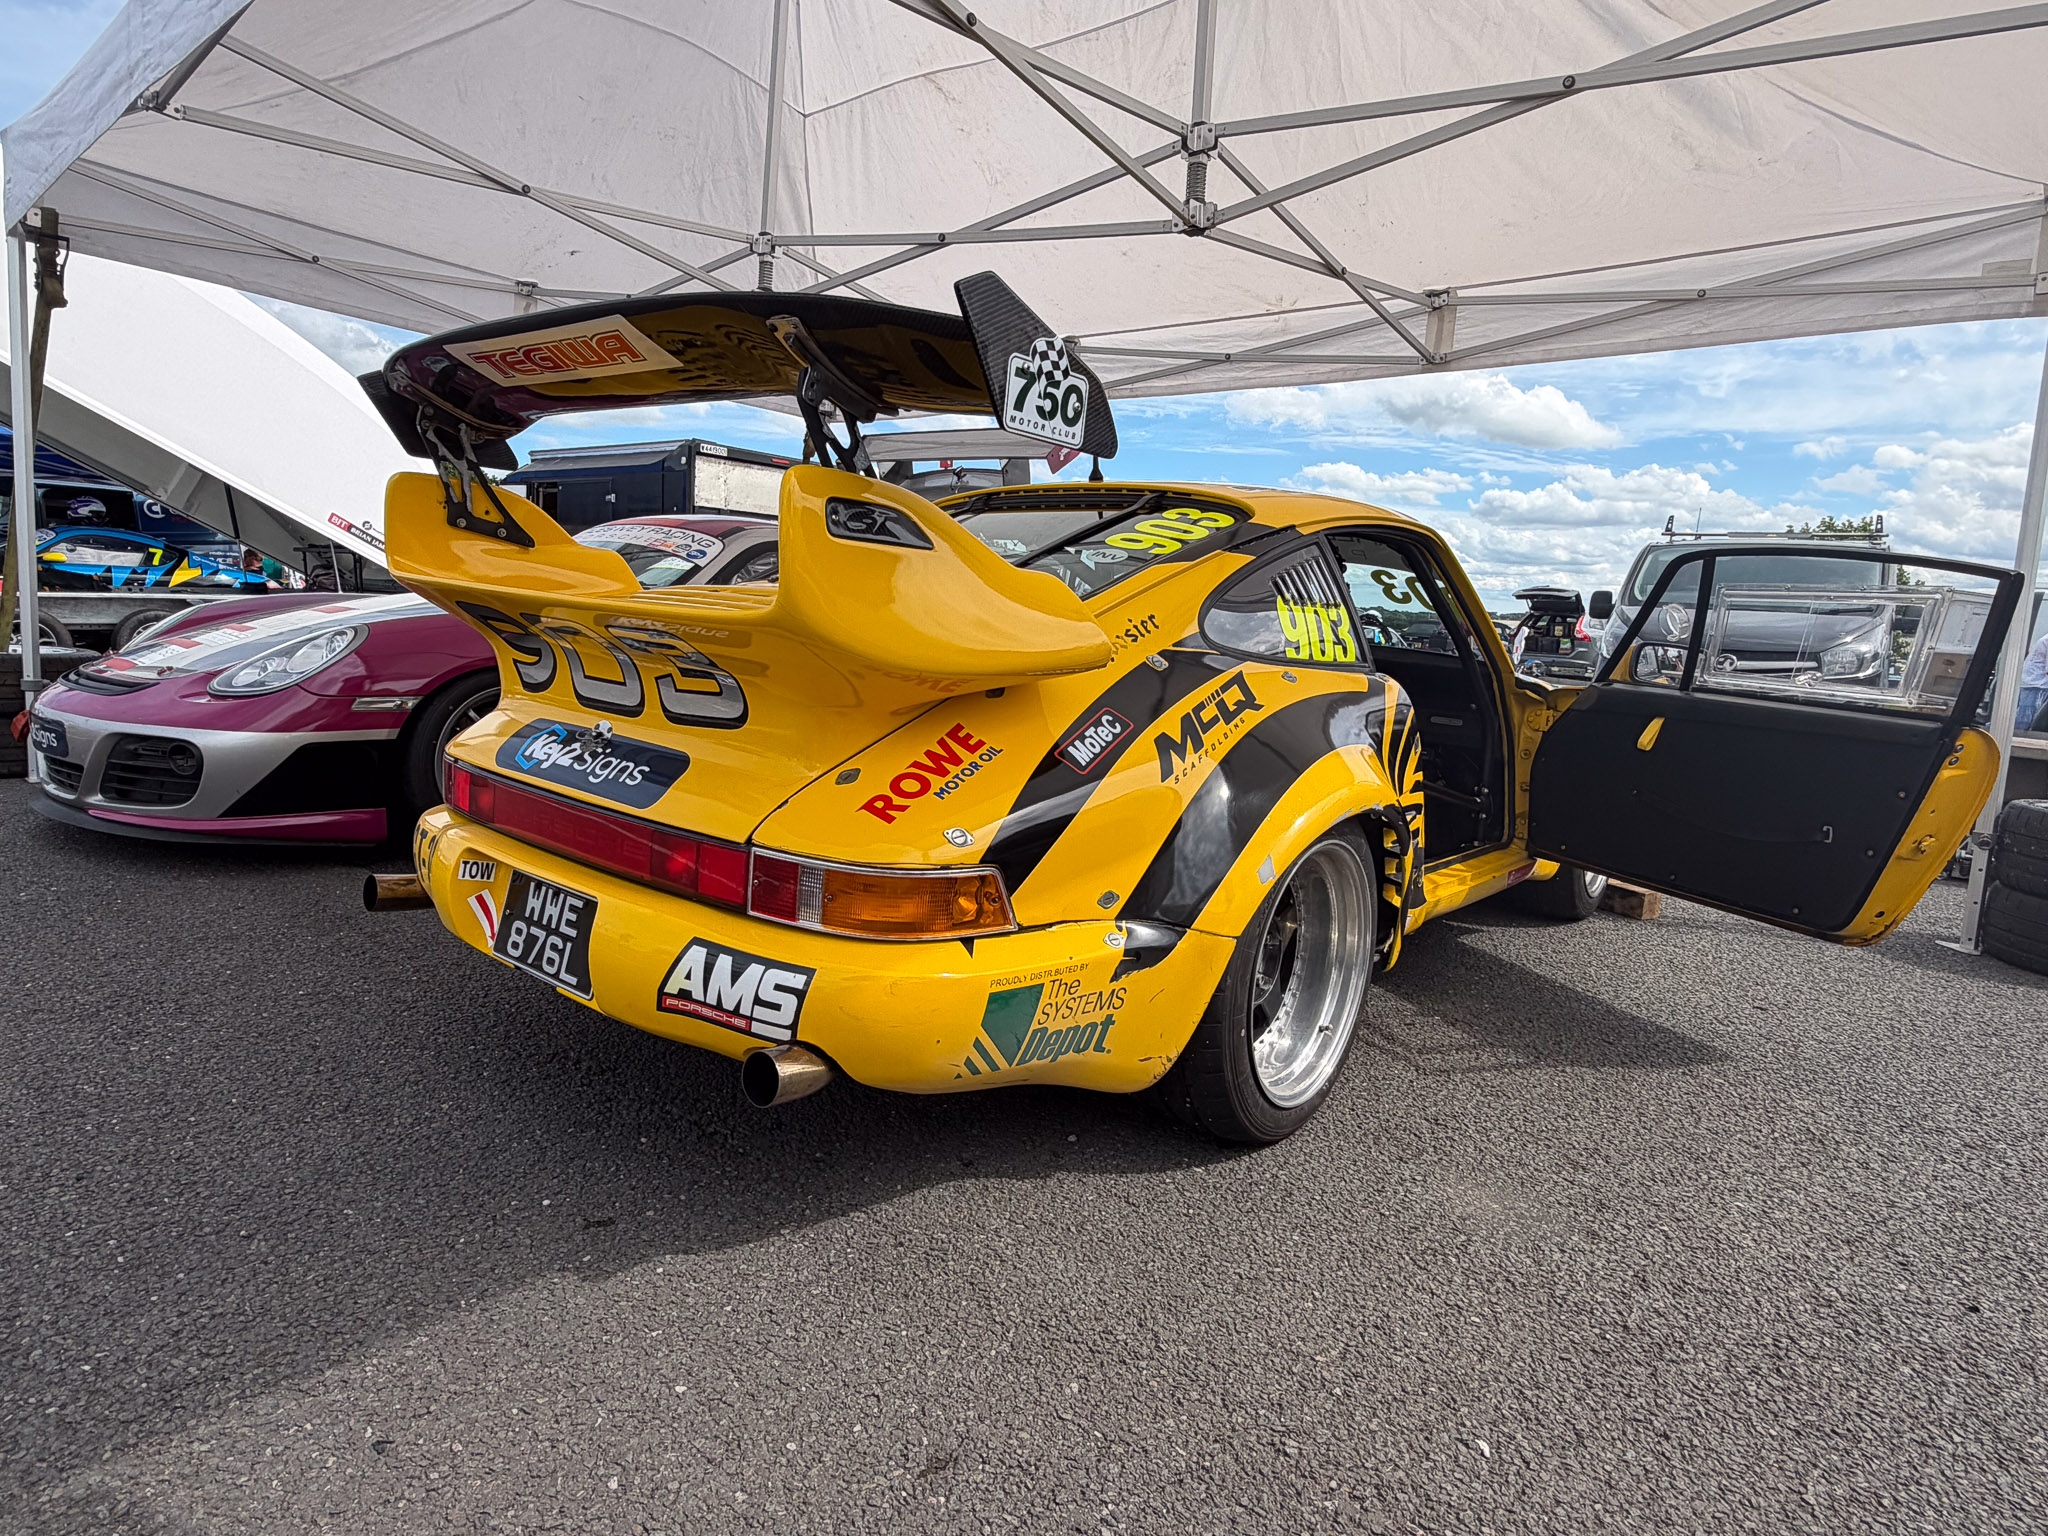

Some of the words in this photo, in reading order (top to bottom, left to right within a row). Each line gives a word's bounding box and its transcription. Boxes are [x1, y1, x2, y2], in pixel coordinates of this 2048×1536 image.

[467, 329, 648, 379] TEGIWA
[1013, 366, 1084, 428] 750
[1009, 415, 1046, 432] MOTOR
[1051, 426, 1077, 440] CLUB
[148, 547, 163, 566] 7
[350, 527, 372, 543] BRIAN
[647, 526, 716, 549] RACING
[1104, 508, 1235, 555] 903
[1277, 594, 1356, 662] 903
[455, 600, 750, 731] 903
[1067, 714, 1122, 767] MoTeC
[1174, 717, 1246, 785] SCAFFOLDING
[855, 722, 987, 825] ROWE
[933, 761, 984, 800] MOTOR
[978, 746, 1004, 763] OIL
[461, 860, 496, 881] TOW
[524, 881, 584, 938] WWE
[506, 920, 578, 986] 876L
[990, 974, 1029, 988] PROUDLY
[1029, 964, 1078, 980] DISTRBUTED
[1079, 962, 1090, 971] BY
[663, 944, 808, 1026] AMS
[1037, 987, 1127, 1025] SYSTEMS
[1048, 978, 1081, 1000] The
[665, 998, 747, 1029] PORSCHE
